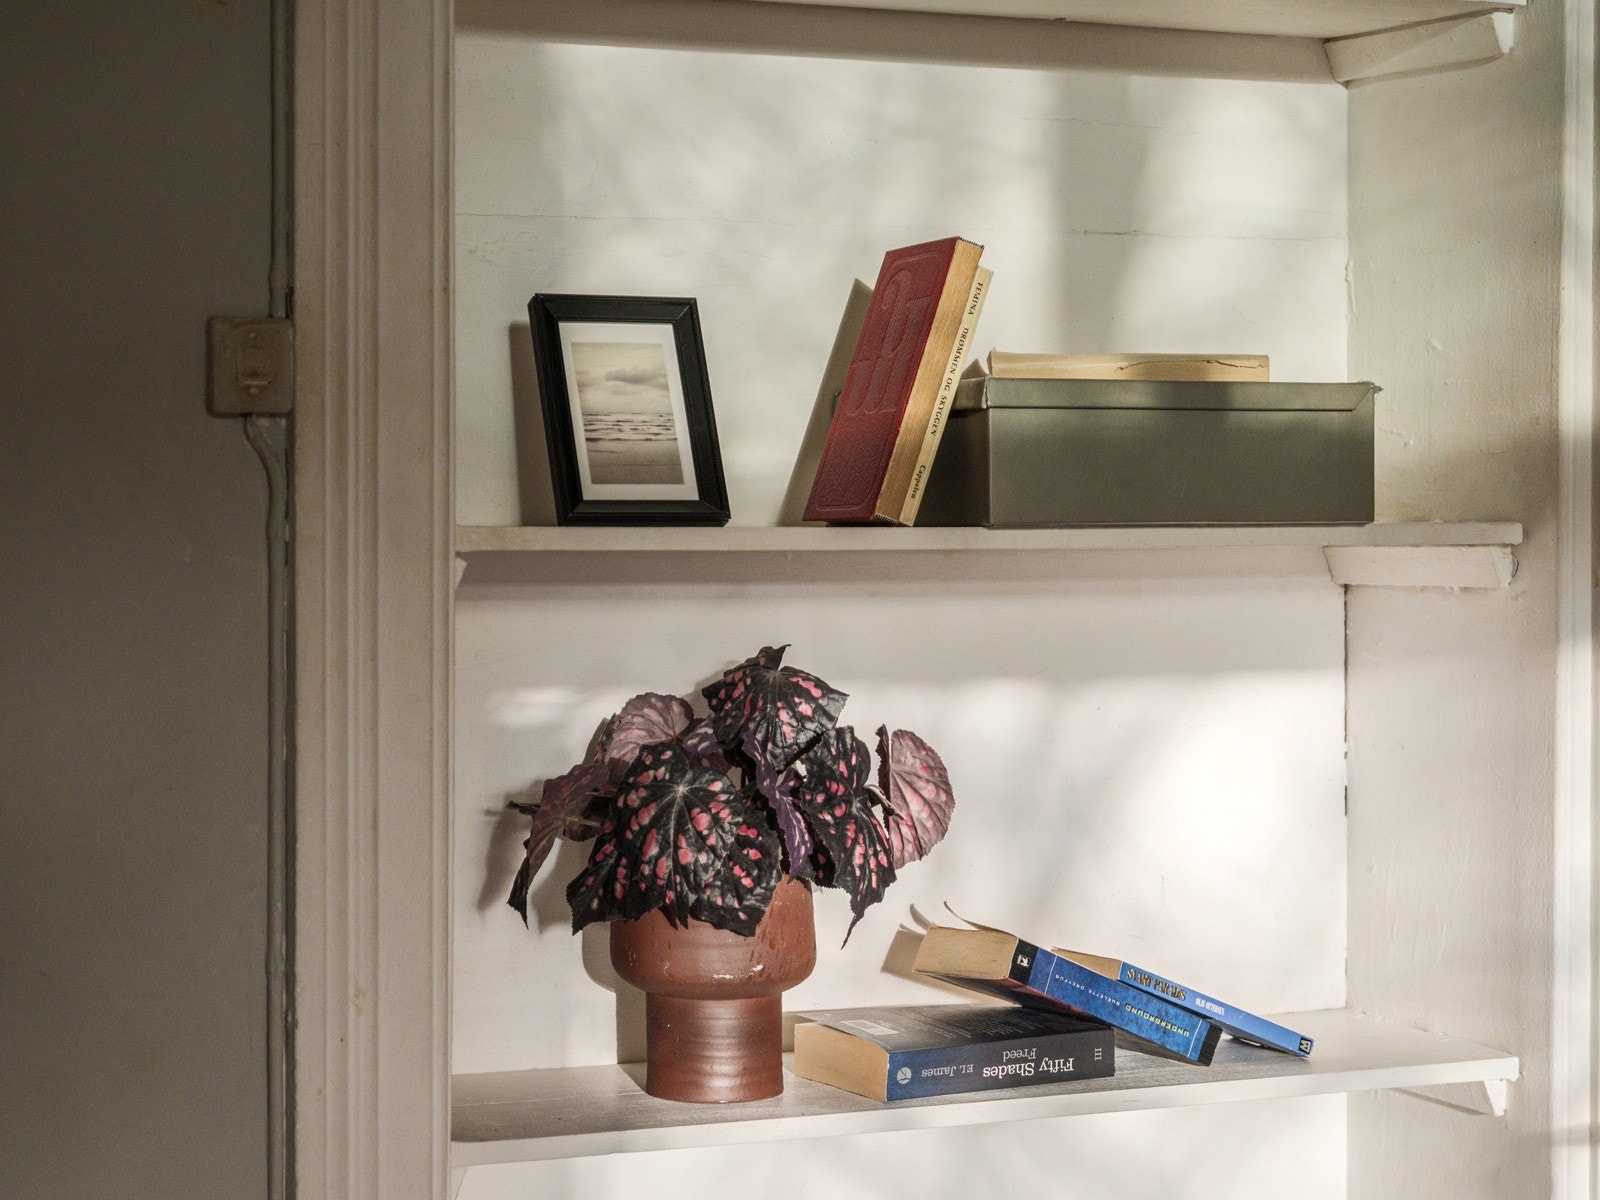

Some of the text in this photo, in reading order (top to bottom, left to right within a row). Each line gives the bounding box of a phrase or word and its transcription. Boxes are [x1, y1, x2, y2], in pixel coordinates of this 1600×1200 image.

[968, 282, 983, 316] FEMINA
[944, 376, 953, 391] OG
[930, 394, 948, 437] SKYGGEN
[910, 464, 926, 499] Cappelen
[1055, 974, 1121, 1006] SUELETTE DREYFUS
[1125, 1003, 1190, 1037] UNDERGROUND
[921, 1065, 957, 1077] James
[982, 1057, 1075, 1079] Fifty Shades
[1002, 1047, 1037, 1063] Freed
